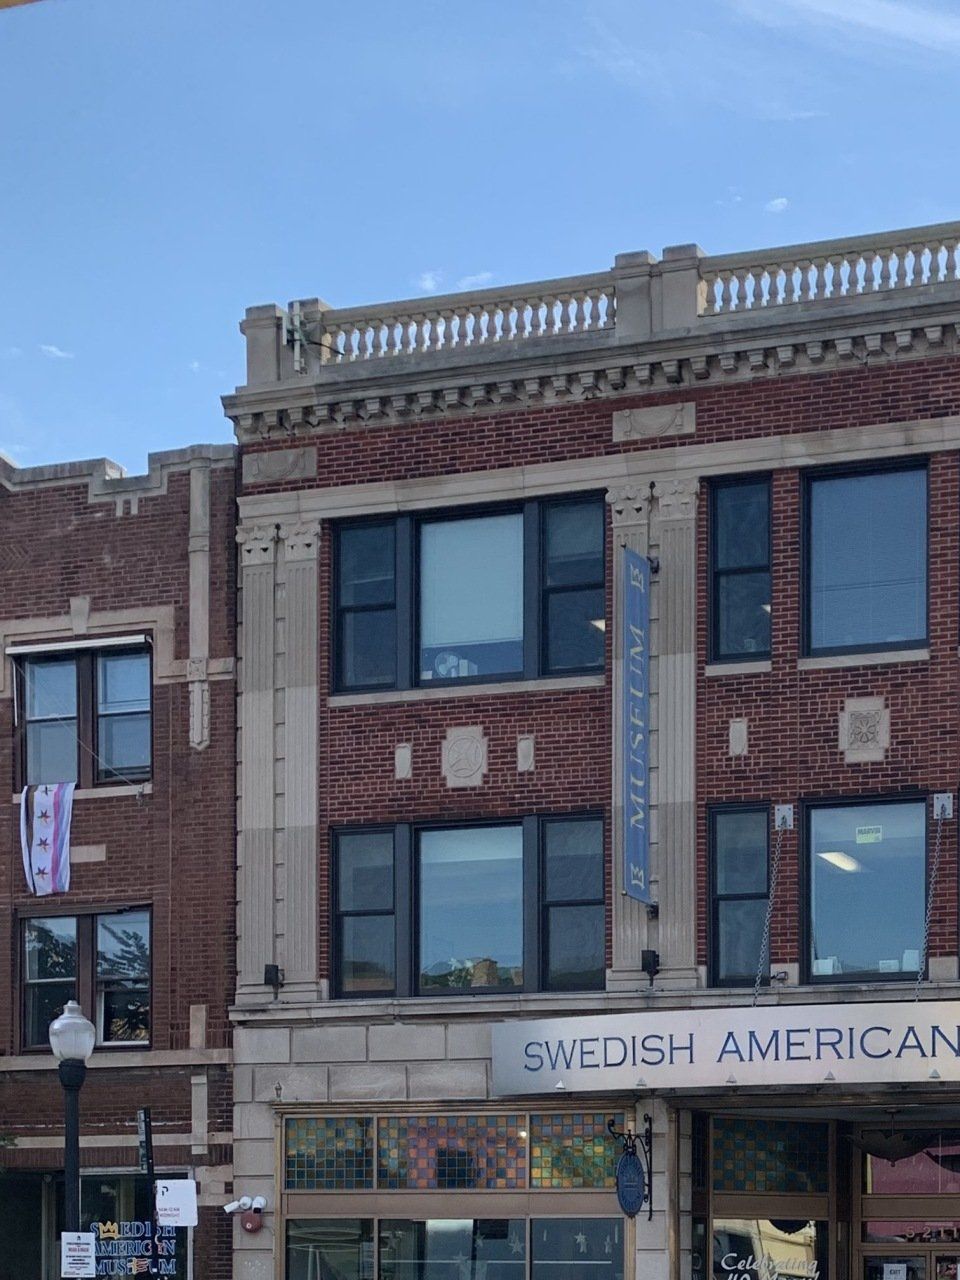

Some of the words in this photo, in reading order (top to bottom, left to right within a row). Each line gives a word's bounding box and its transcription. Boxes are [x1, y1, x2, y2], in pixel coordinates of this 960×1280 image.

[629, 623, 645, 832] MUSEUM
[523, 1033, 695, 1072] SWEDISH
[905, 1227, 958, 1238] 5211
[721, 1253, 818, 1278] Celebrating
